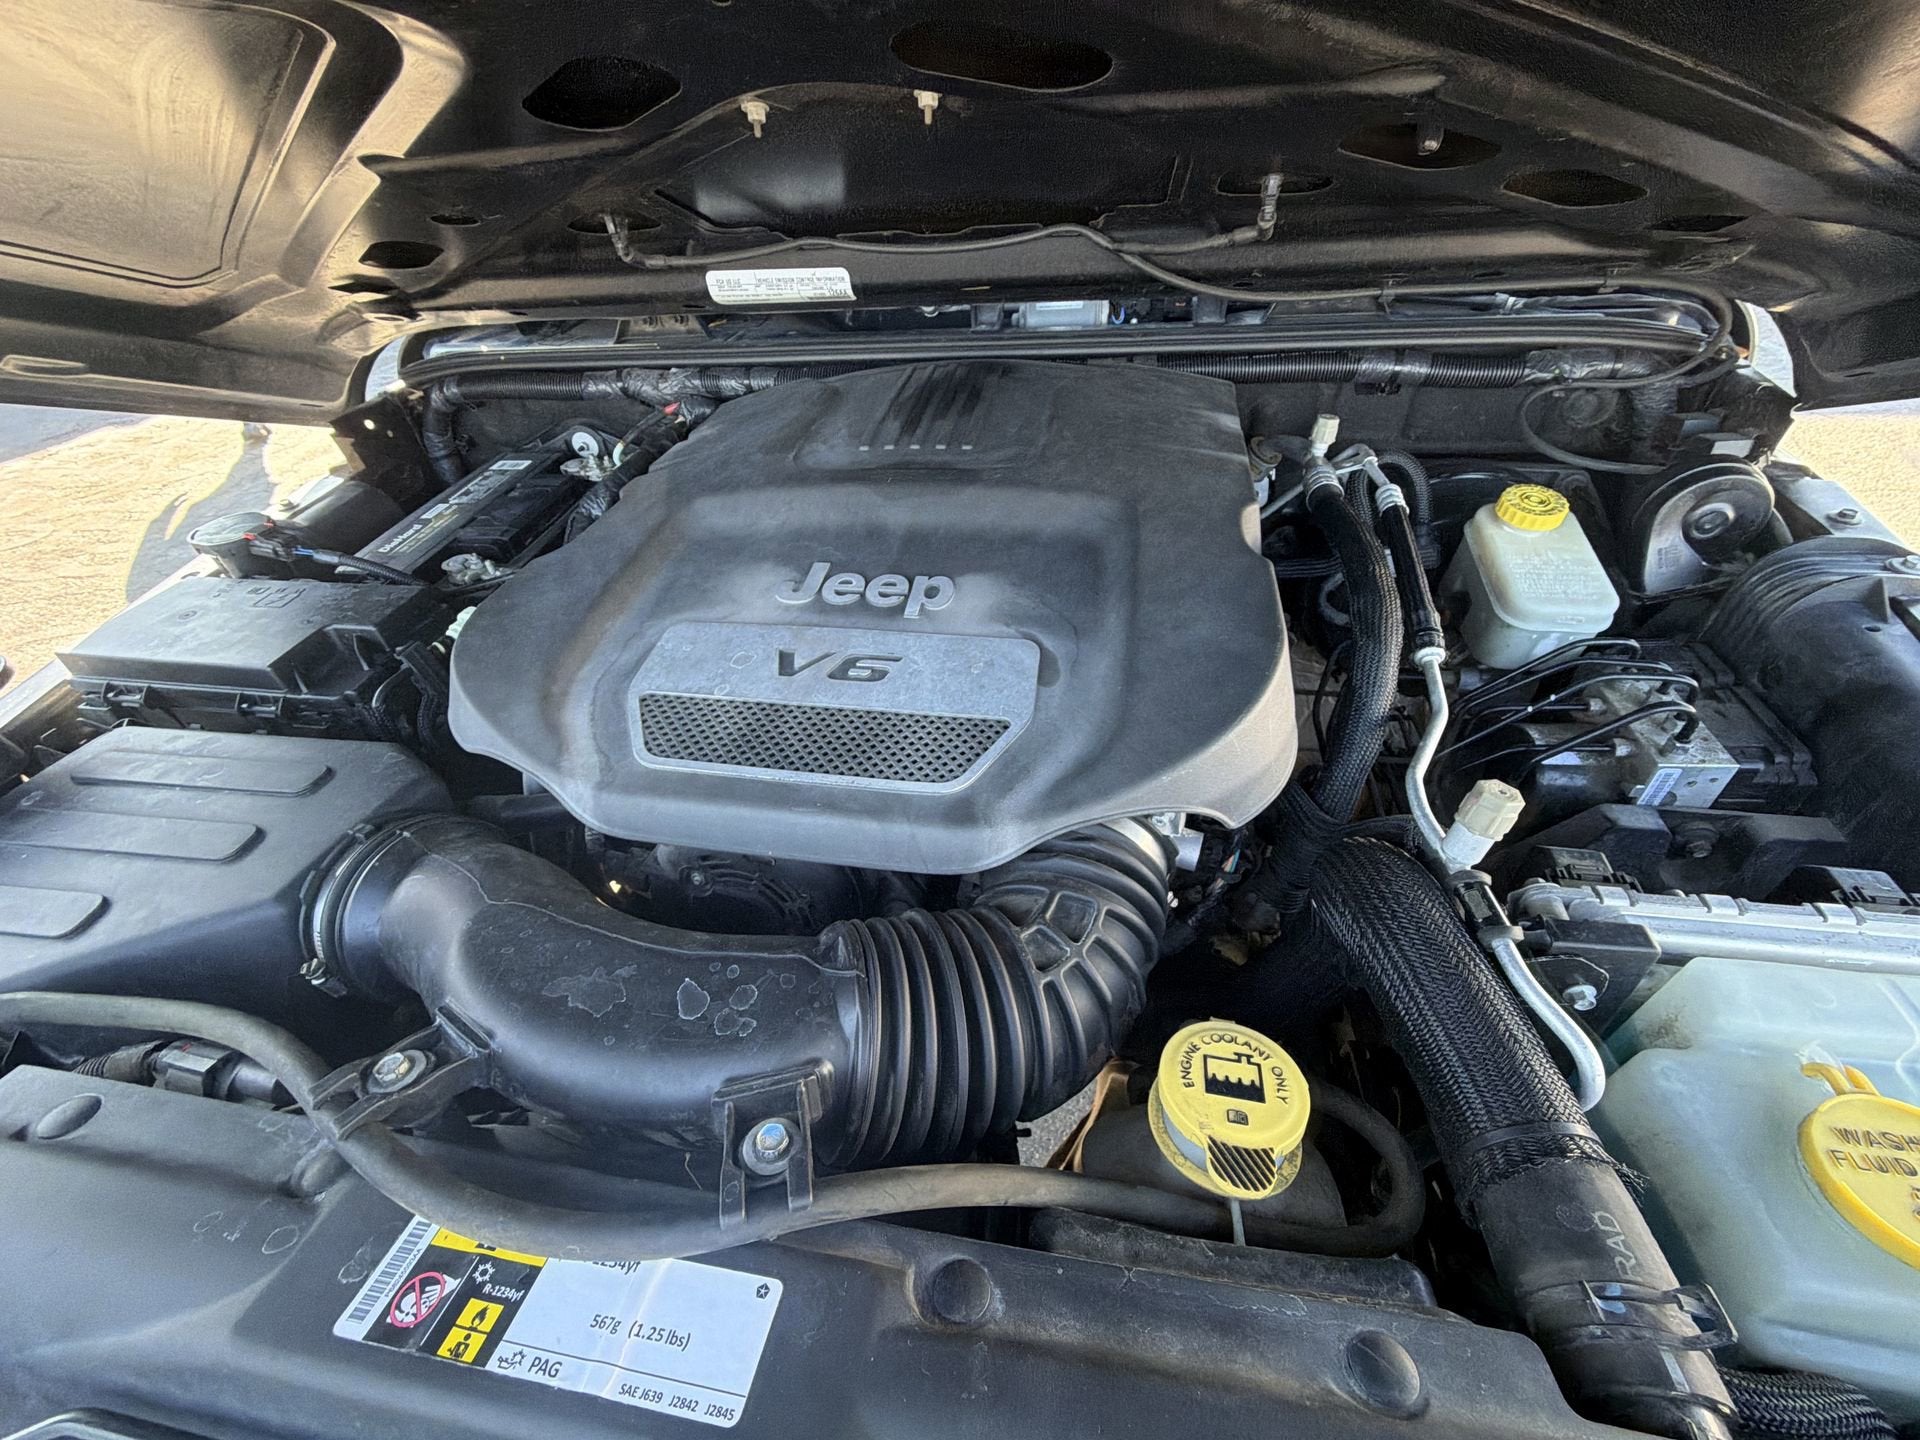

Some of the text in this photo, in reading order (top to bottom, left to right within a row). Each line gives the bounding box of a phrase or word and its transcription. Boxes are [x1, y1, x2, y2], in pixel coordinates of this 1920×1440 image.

[775, 561, 956, 619] Jeep
[777, 649, 904, 682] V6
[1180, 1033, 1290, 1104] ENGINE COOLANT ONLY
[1826, 1149, 1919, 1177] FLUID
[1593, 1210, 1642, 1282] RAD
[482, 1283, 526, 1303] R-1234yf
[590, 1314, 691, 1352] 567g (1.25 lbs)
[527, 1356, 563, 1379] PAG
[618, 1383, 736, 1421] SAE J639 J2842 J2845
